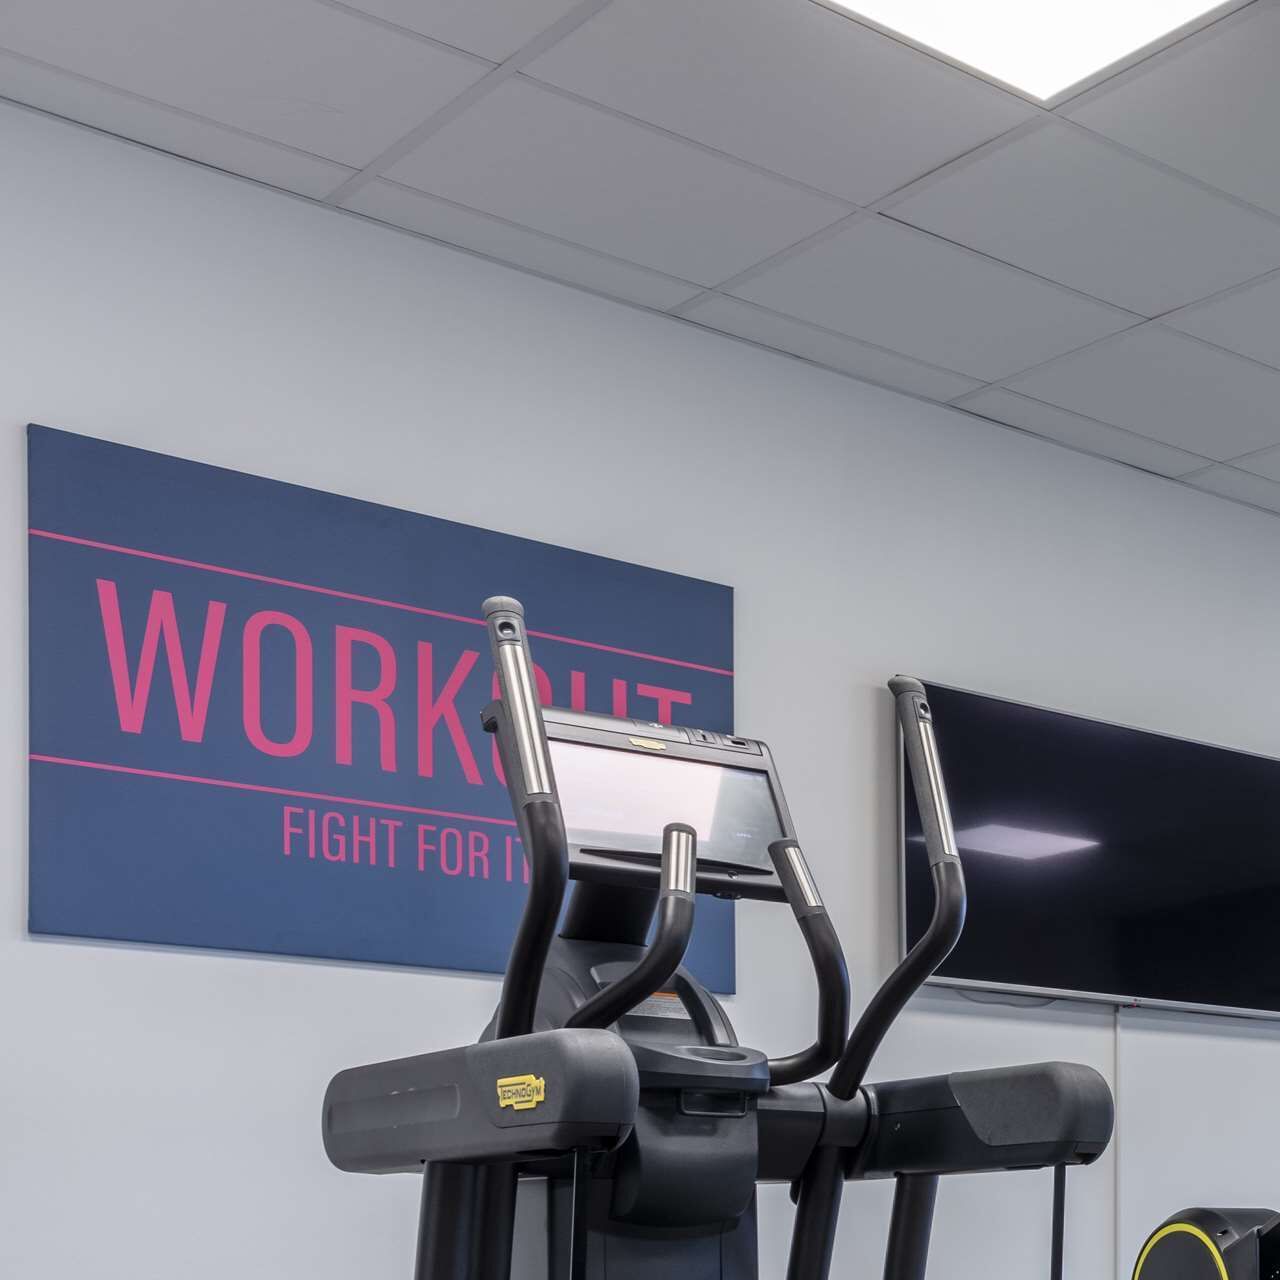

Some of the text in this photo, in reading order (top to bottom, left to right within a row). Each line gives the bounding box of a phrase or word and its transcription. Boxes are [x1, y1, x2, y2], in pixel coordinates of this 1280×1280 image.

[96, 578, 693, 787] WORK
[283, 805, 403, 869] FIGHT
[417, 824, 490, 880] FOR
